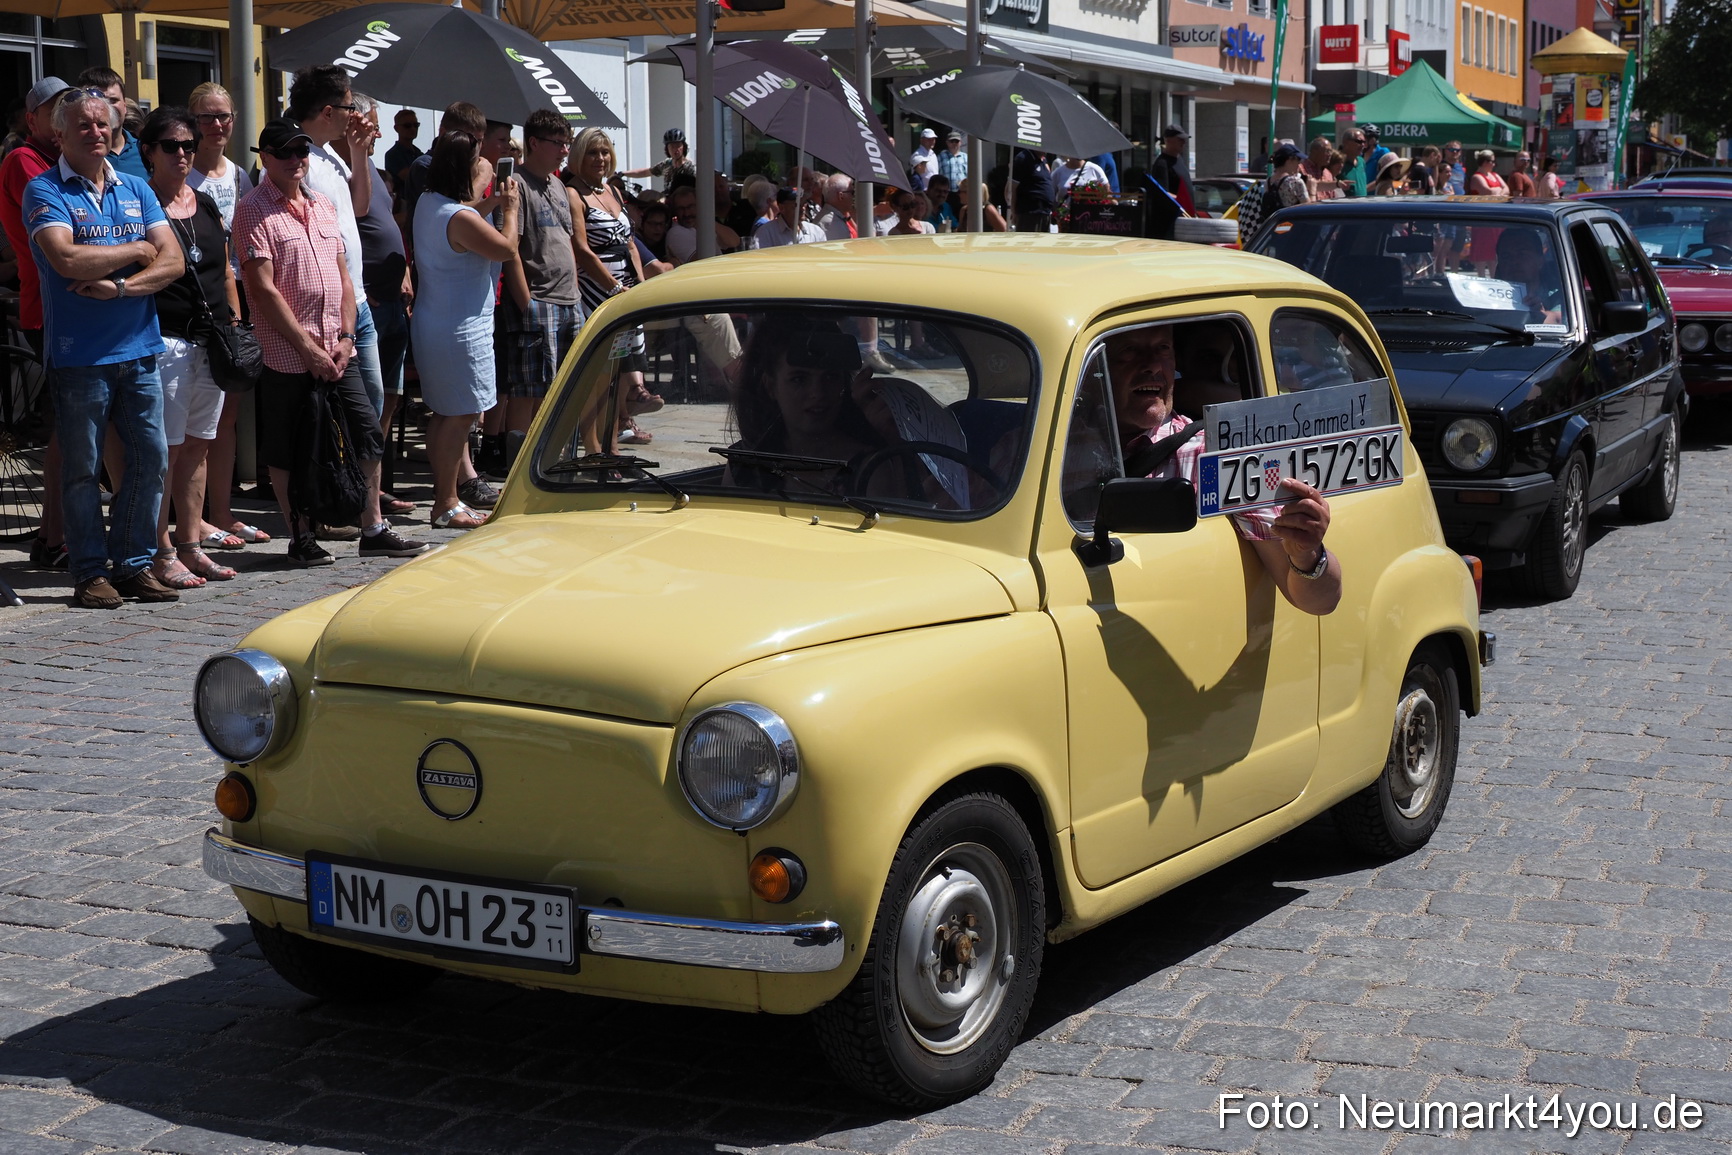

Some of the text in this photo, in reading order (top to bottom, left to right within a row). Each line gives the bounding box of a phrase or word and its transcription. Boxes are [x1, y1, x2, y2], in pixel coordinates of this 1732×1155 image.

[1324, 37, 1352, 48] WITT
[332, 27, 402, 78] now
[518, 54, 583, 114] now
[904, 73, 957, 96] now
[1016, 100, 1042, 143] now
[1384, 124, 1429, 137] DEKRA
[1488, 287, 1514, 300] 256
[1218, 413, 1287, 451] Balkan
[1221, 454, 1262, 505] ZG
[1202, 493, 1217, 507] HR
[424, 772, 475, 787] ZASTAVA
[318, 900, 327, 915] D
[334, 872, 536, 949] NM OH 23
[544, 901, 564, 918] 03
[546, 938, 564, 954] 11
